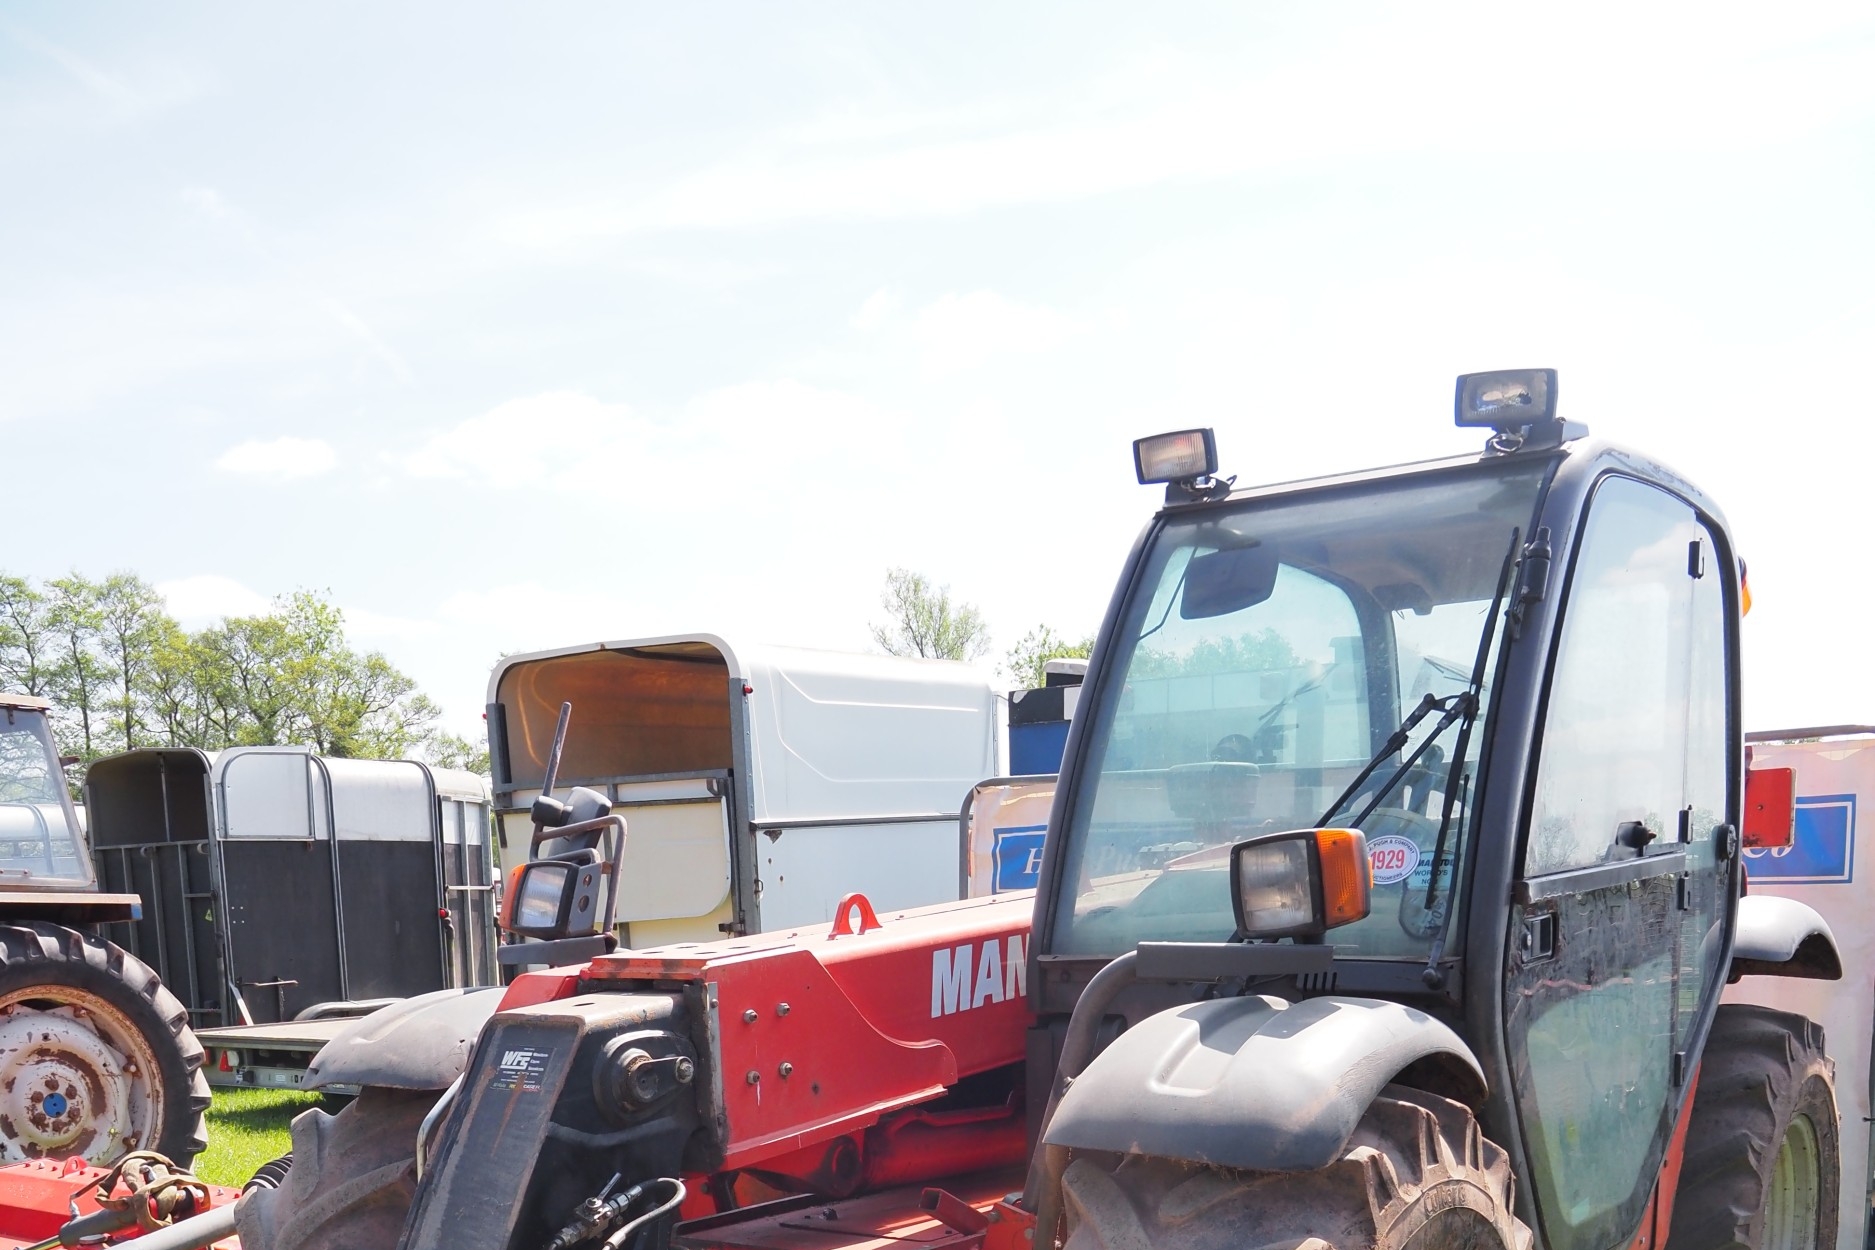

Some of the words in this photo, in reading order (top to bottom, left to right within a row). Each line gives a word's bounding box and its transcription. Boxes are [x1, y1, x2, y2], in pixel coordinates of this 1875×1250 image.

[1373, 839, 1389, 847] PUGH
[1394, 839, 1415, 854] COMPANY
[1371, 849, 1405, 870] 1929
[931, 933, 1030, 1018] MAN
[500, 1051, 532, 1070] WFS
